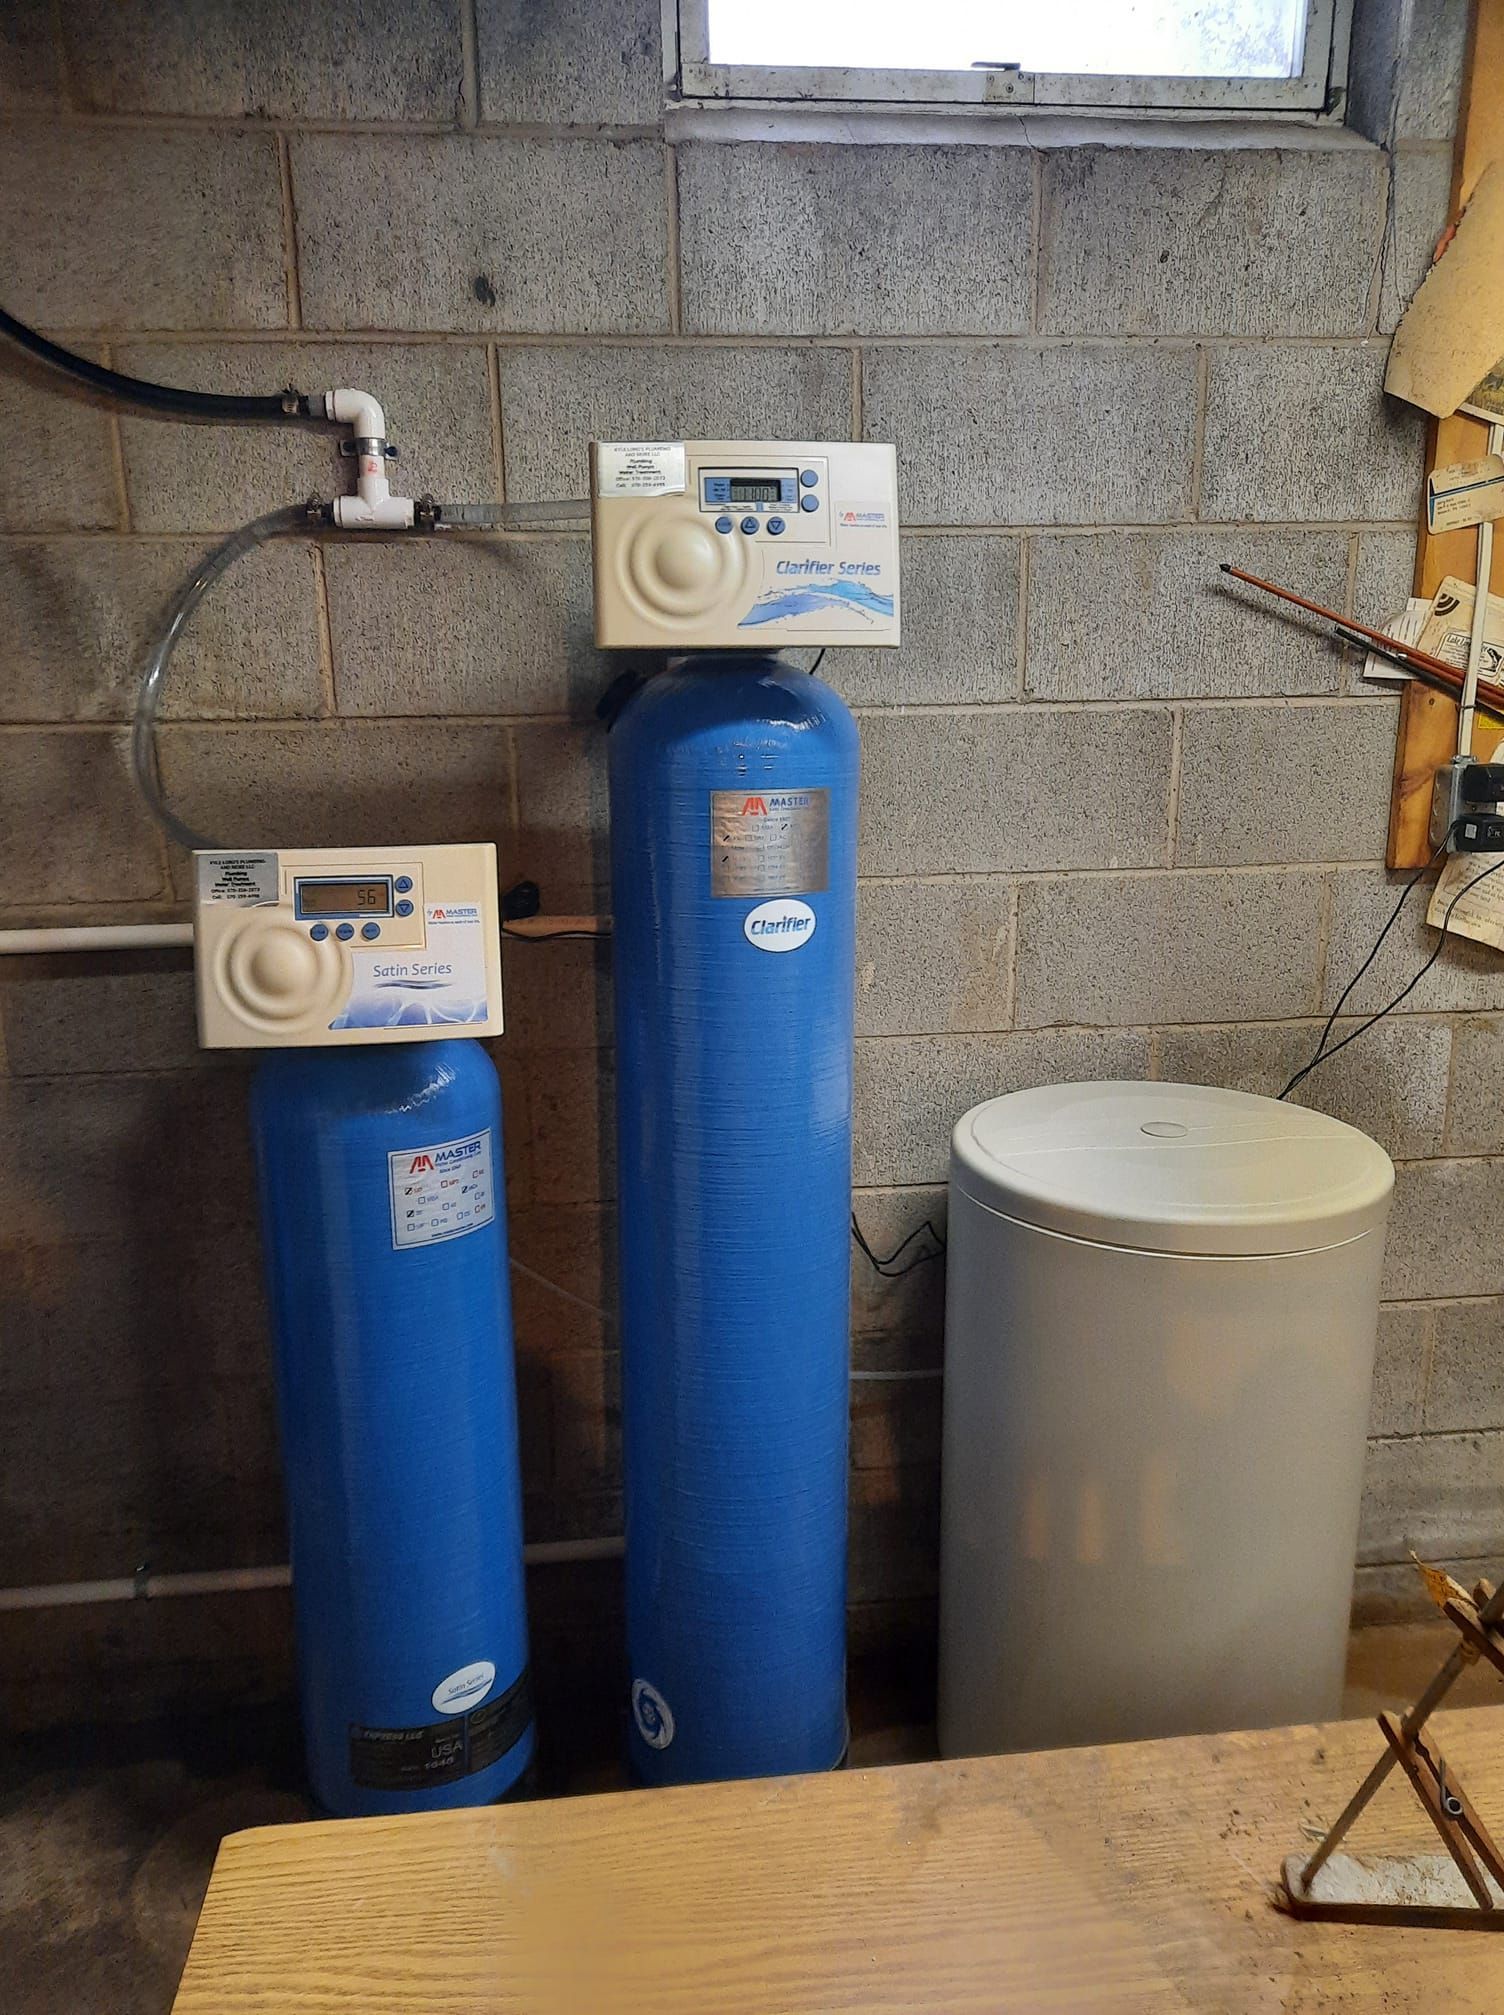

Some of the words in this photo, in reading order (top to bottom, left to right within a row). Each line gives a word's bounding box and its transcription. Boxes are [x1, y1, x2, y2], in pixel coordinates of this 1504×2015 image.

[776, 558, 834, 576] Clarifier
[838, 560, 881, 576] Series
[769, 796, 809, 807] MASTER
[751, 915, 812, 936] Clarifier
[373, 964, 409, 978] Satin
[412, 962, 452, 976] Series
[435, 1141, 481, 1162] MASTER
[432, 1741, 463, 1758] USA
